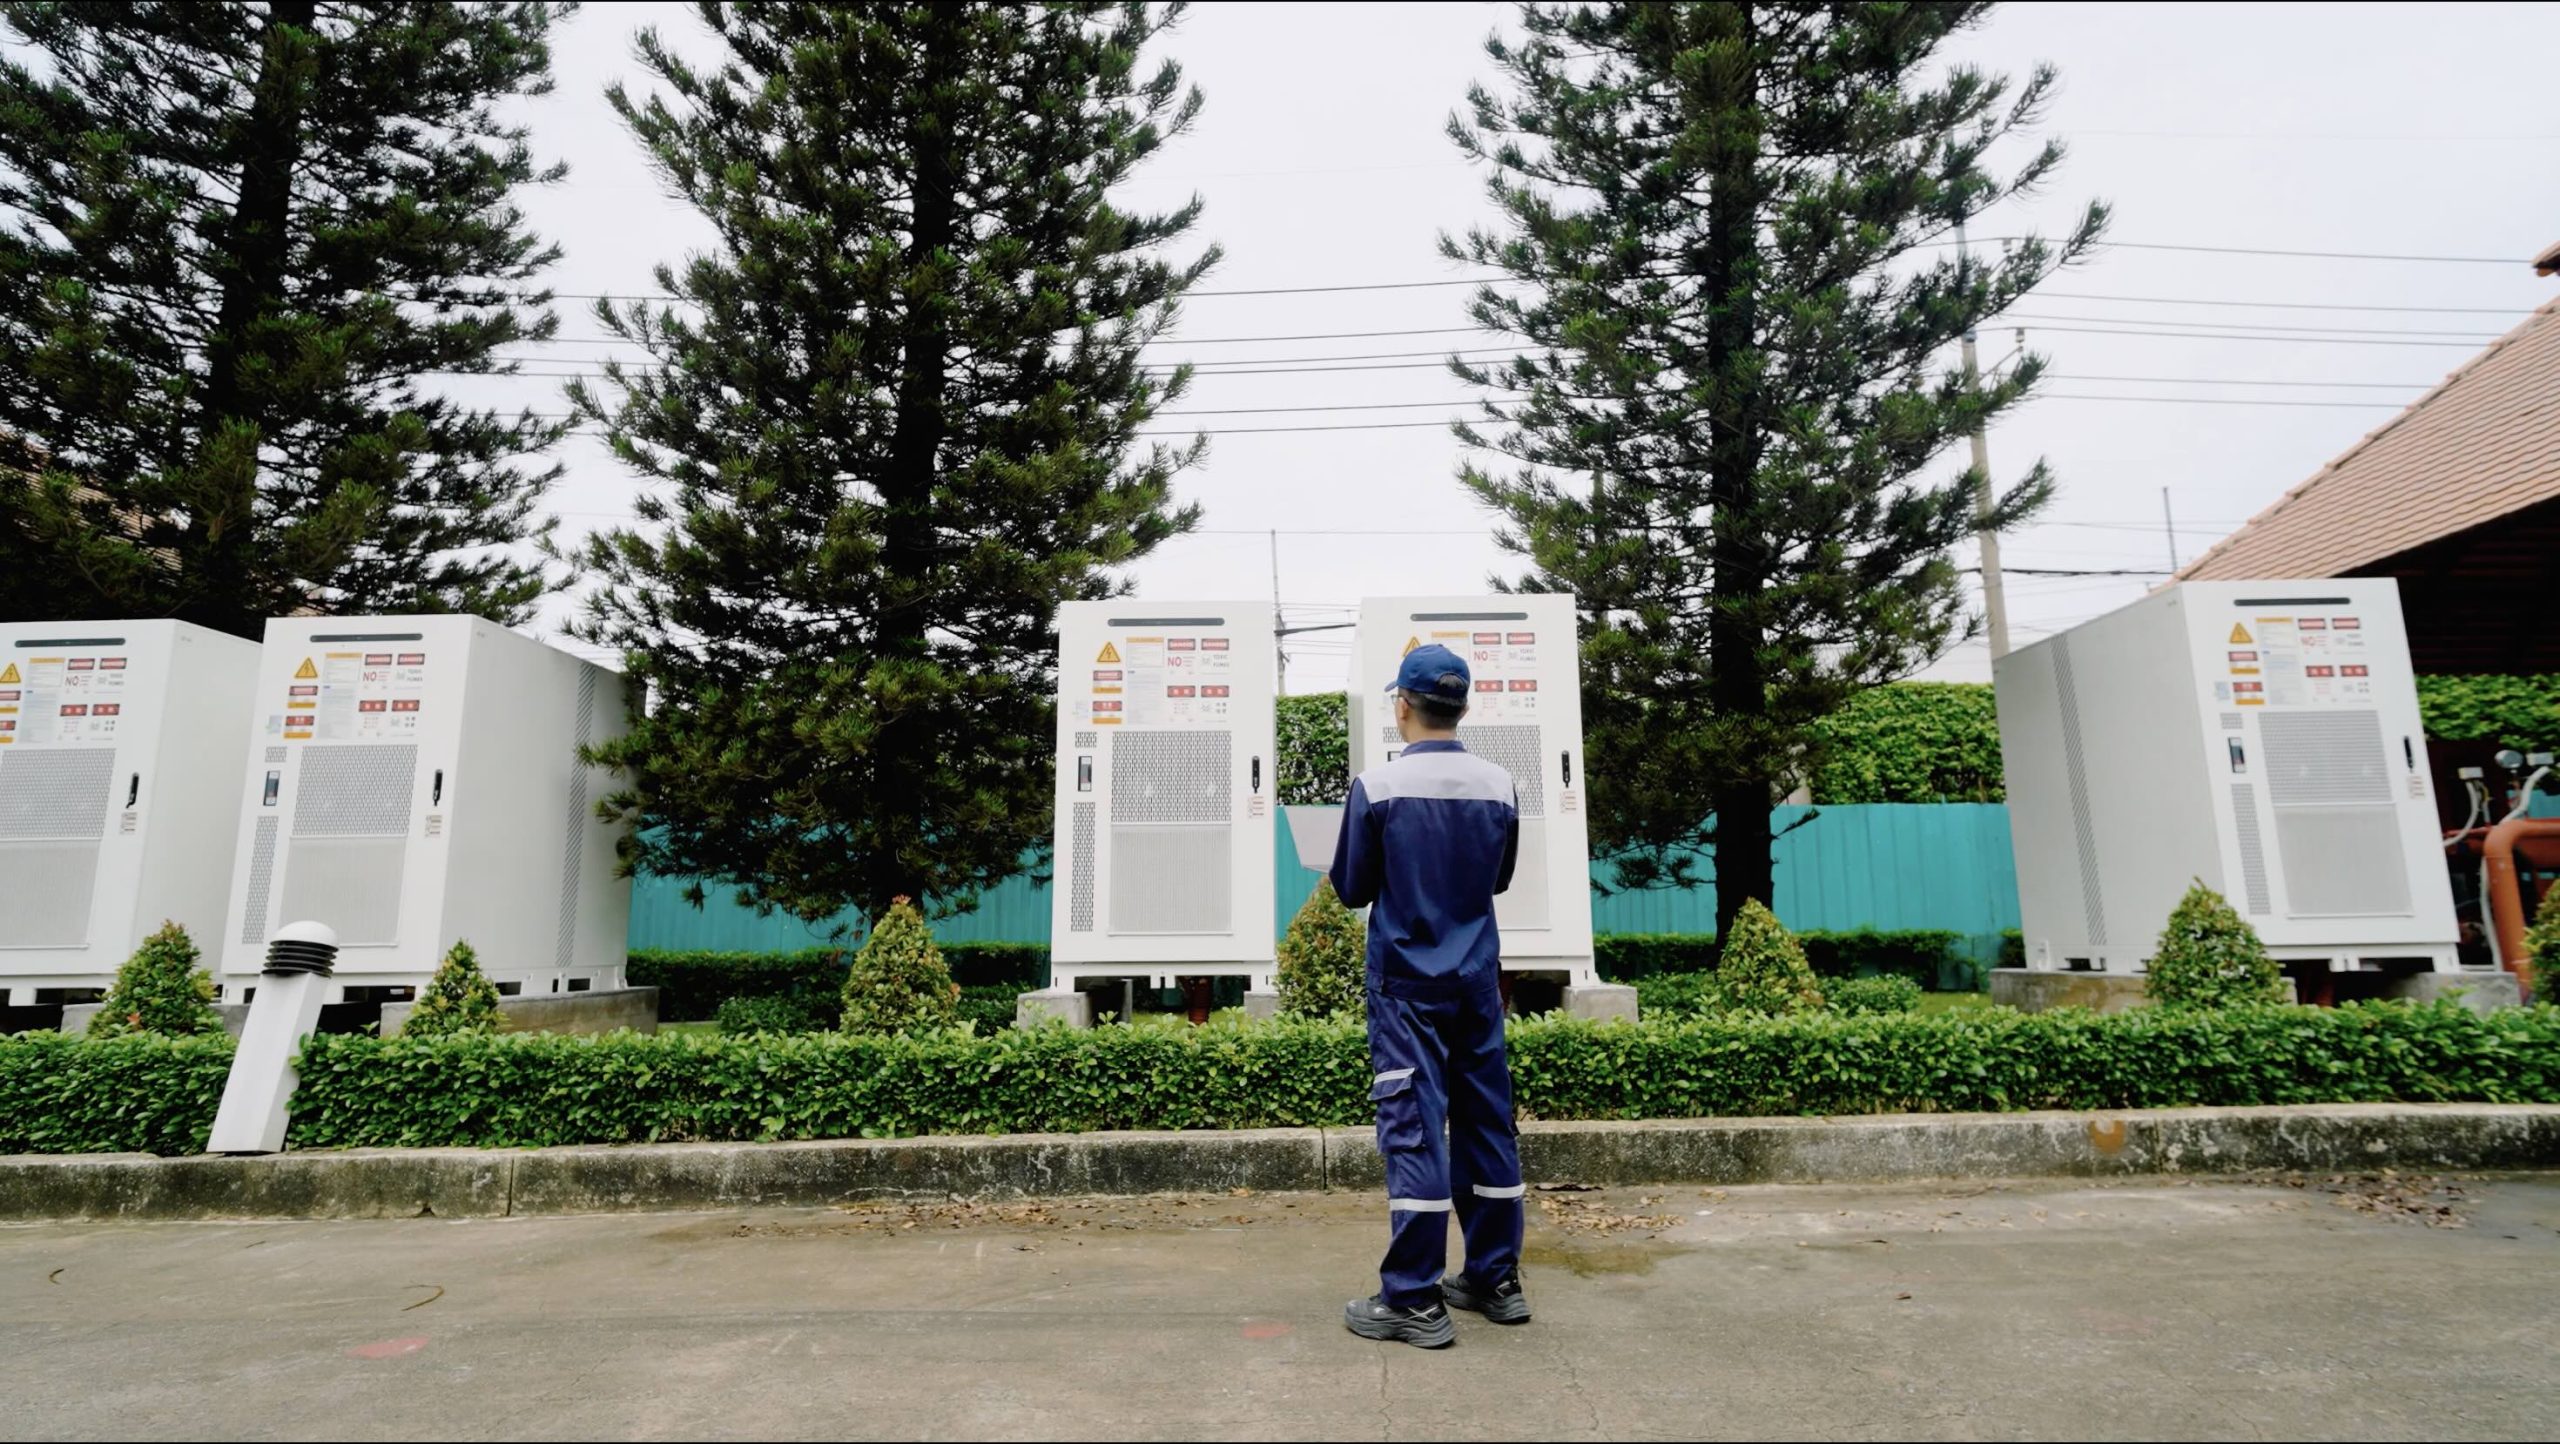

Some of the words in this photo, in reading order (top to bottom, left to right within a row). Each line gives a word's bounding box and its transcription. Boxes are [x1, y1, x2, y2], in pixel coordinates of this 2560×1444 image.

[1168, 656, 1182, 667] NO
[1474, 651, 1488, 661] NO
[363, 671, 377, 682] NO
